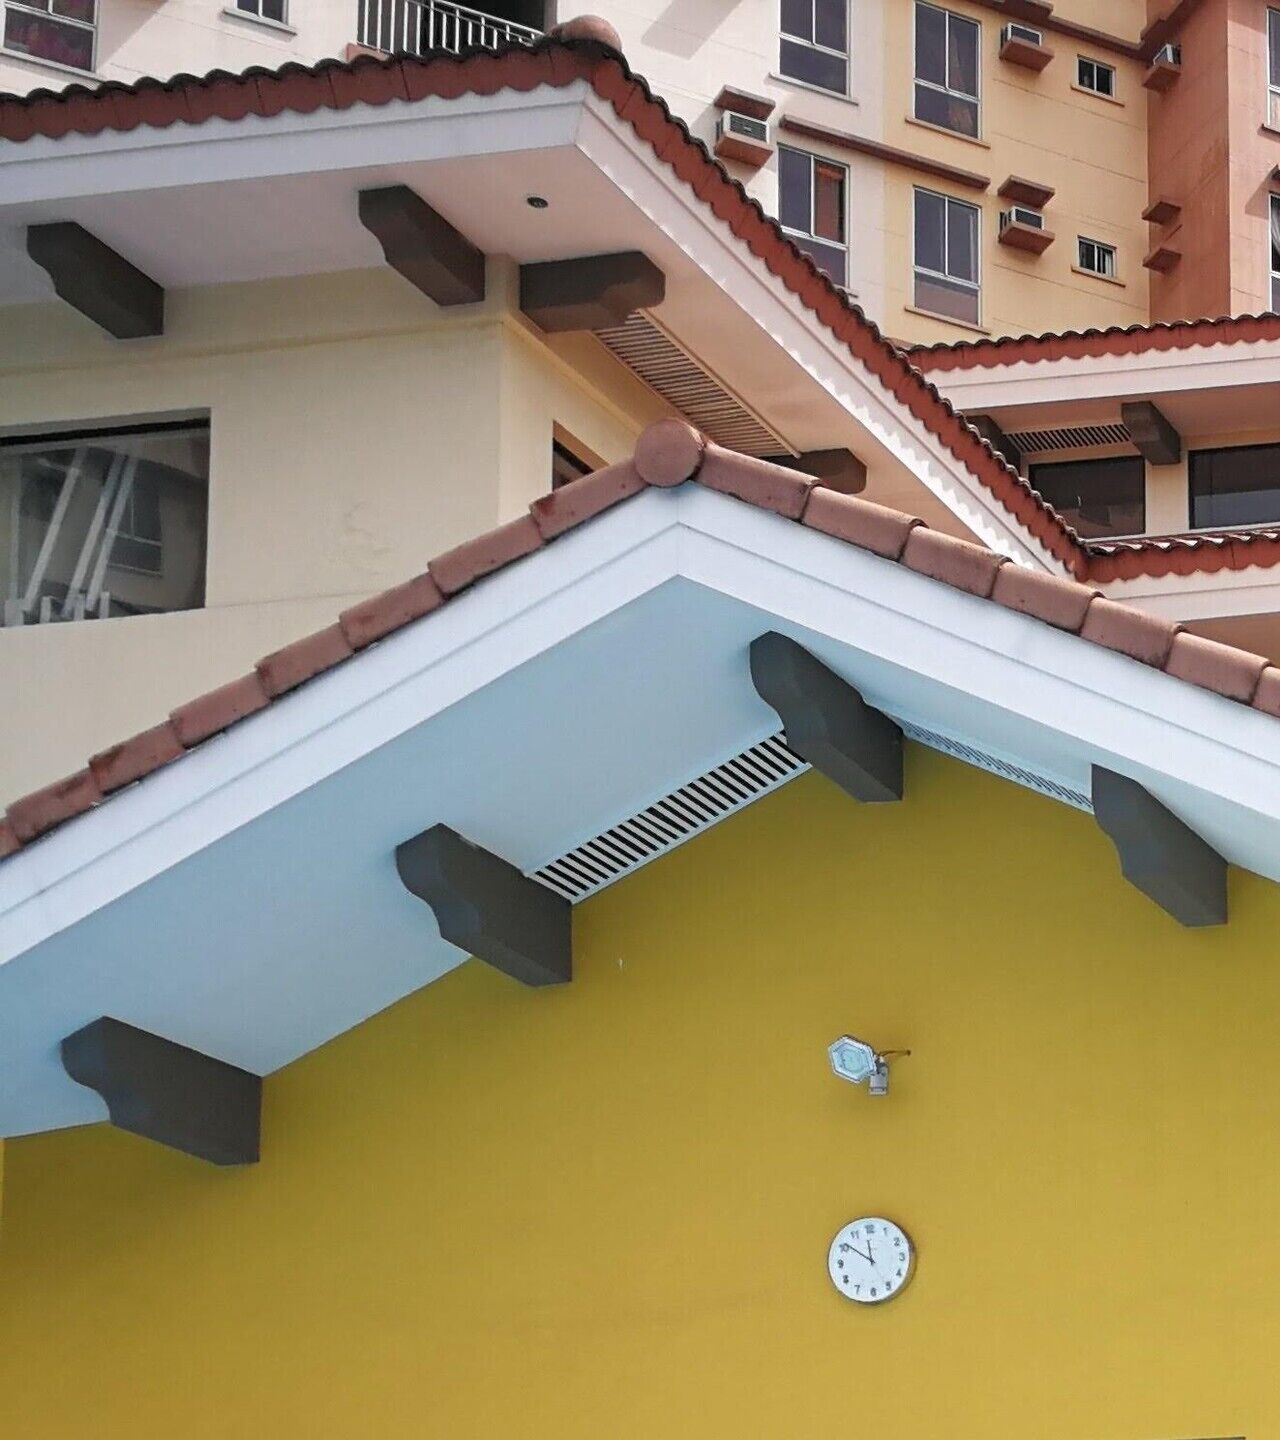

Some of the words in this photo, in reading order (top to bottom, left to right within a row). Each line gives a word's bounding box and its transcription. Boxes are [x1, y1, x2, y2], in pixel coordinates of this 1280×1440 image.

[864, 1224, 875, 1234] 12
[883, 1227, 889, 1236] 1
[850, 1230, 859, 1239] 11
[893, 1237, 900, 1247] 2
[899, 1252, 905, 1261] 3
[837, 1259, 844, 1269] 9
[896, 1268, 901, 1277] 4
[843, 1274, 849, 1284] 8
[854, 1284, 860, 1295] 7
[885, 1281, 891, 1291] 5
[870, 1287, 877, 1297] 6
